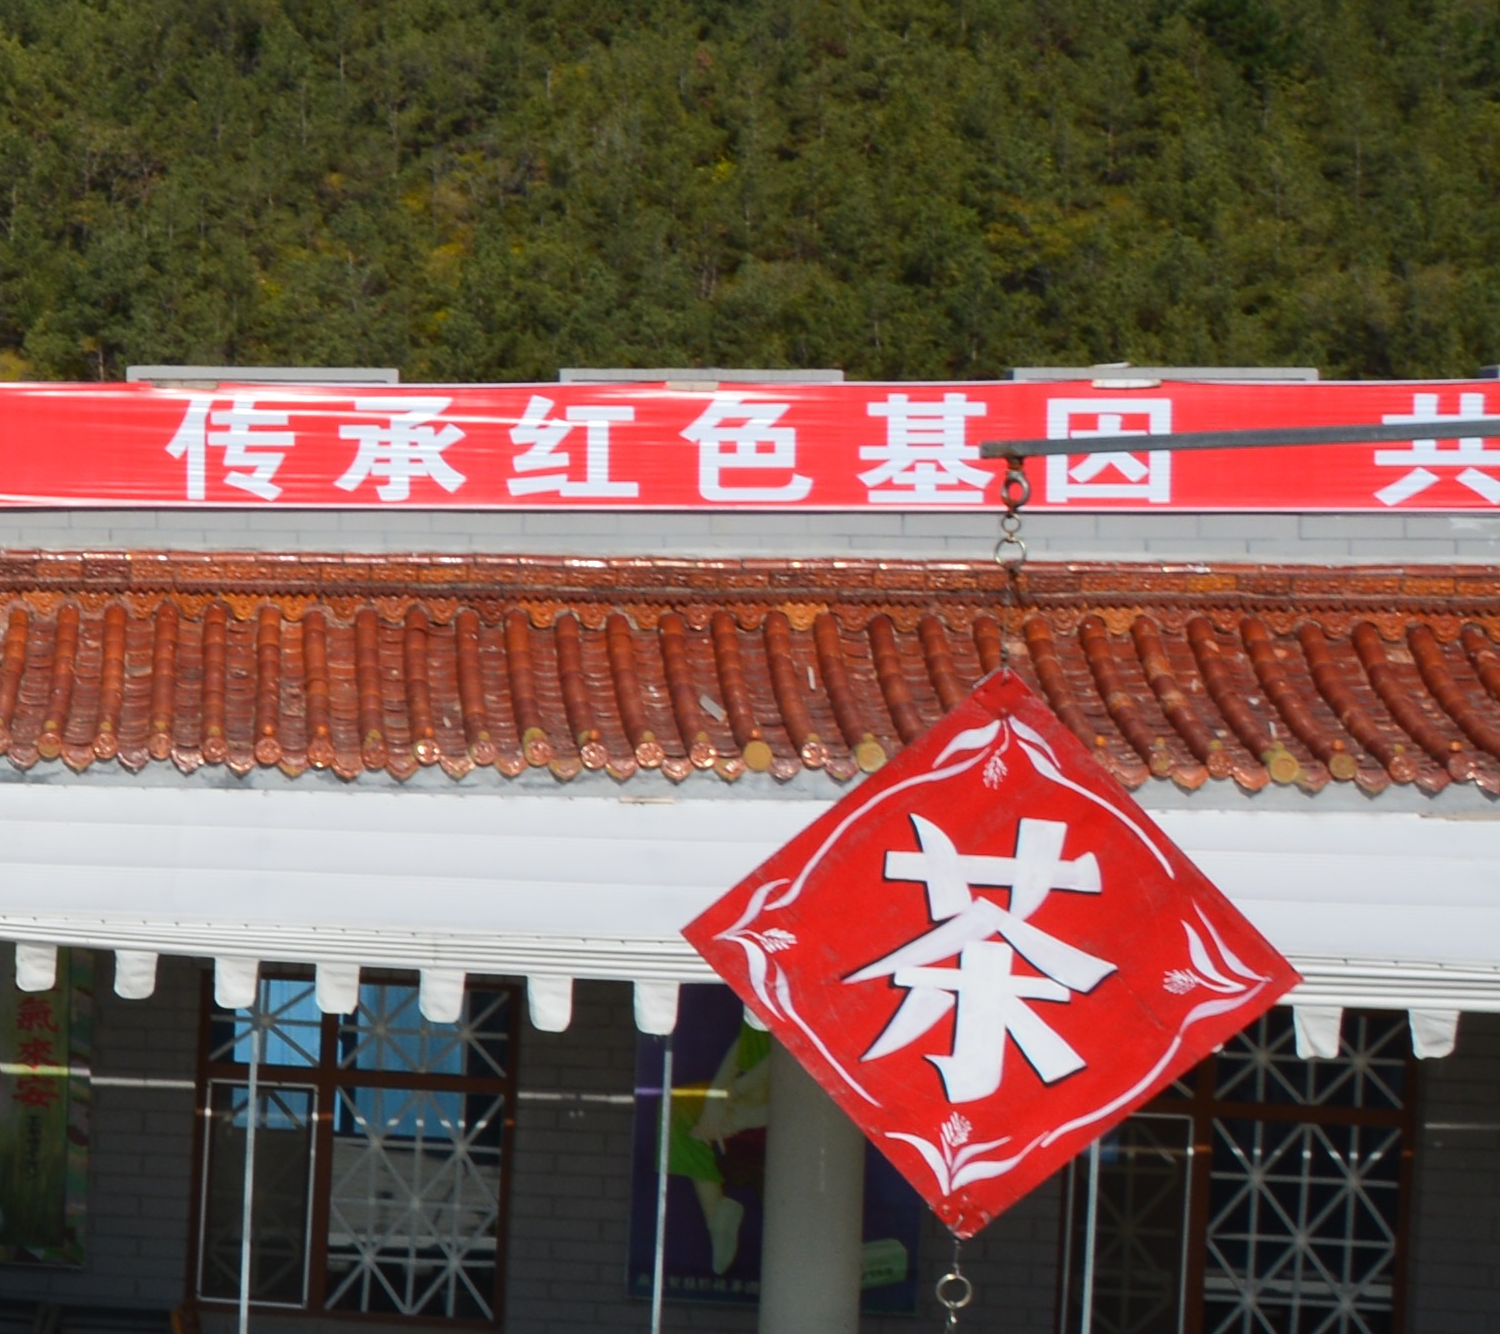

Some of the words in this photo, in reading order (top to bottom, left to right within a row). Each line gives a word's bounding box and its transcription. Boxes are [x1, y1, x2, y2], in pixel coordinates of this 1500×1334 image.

[166, 392, 1173, 506] 传承红色基因
[1373, 393, 1500, 507] 共
[841, 812, 1118, 1104] 茶
